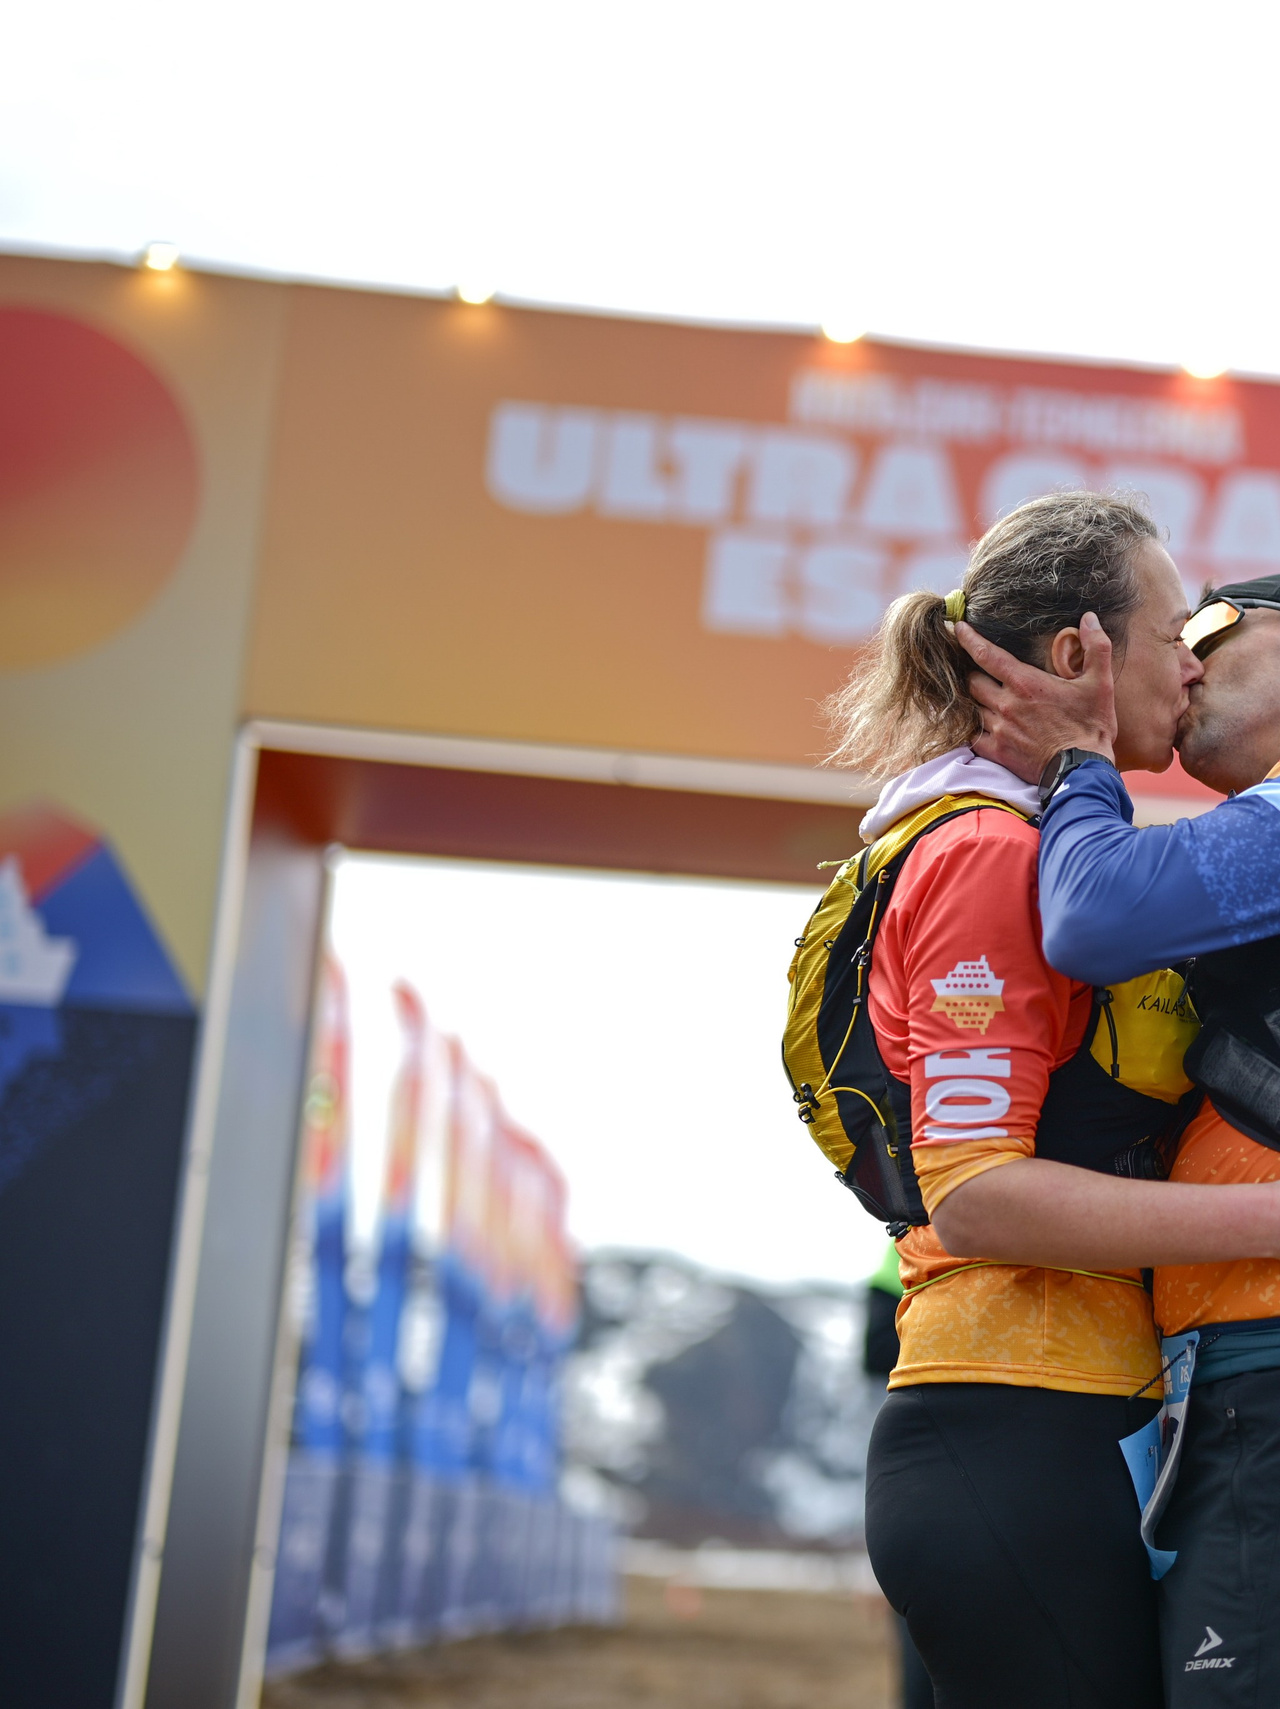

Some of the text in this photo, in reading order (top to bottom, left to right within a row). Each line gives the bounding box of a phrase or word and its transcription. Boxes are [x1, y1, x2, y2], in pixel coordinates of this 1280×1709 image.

[485, 402, 966, 539] ULTRA
[1137, 994, 1186, 1017] KAILAS
[1184, 1657, 1236, 1672] DEMIX
